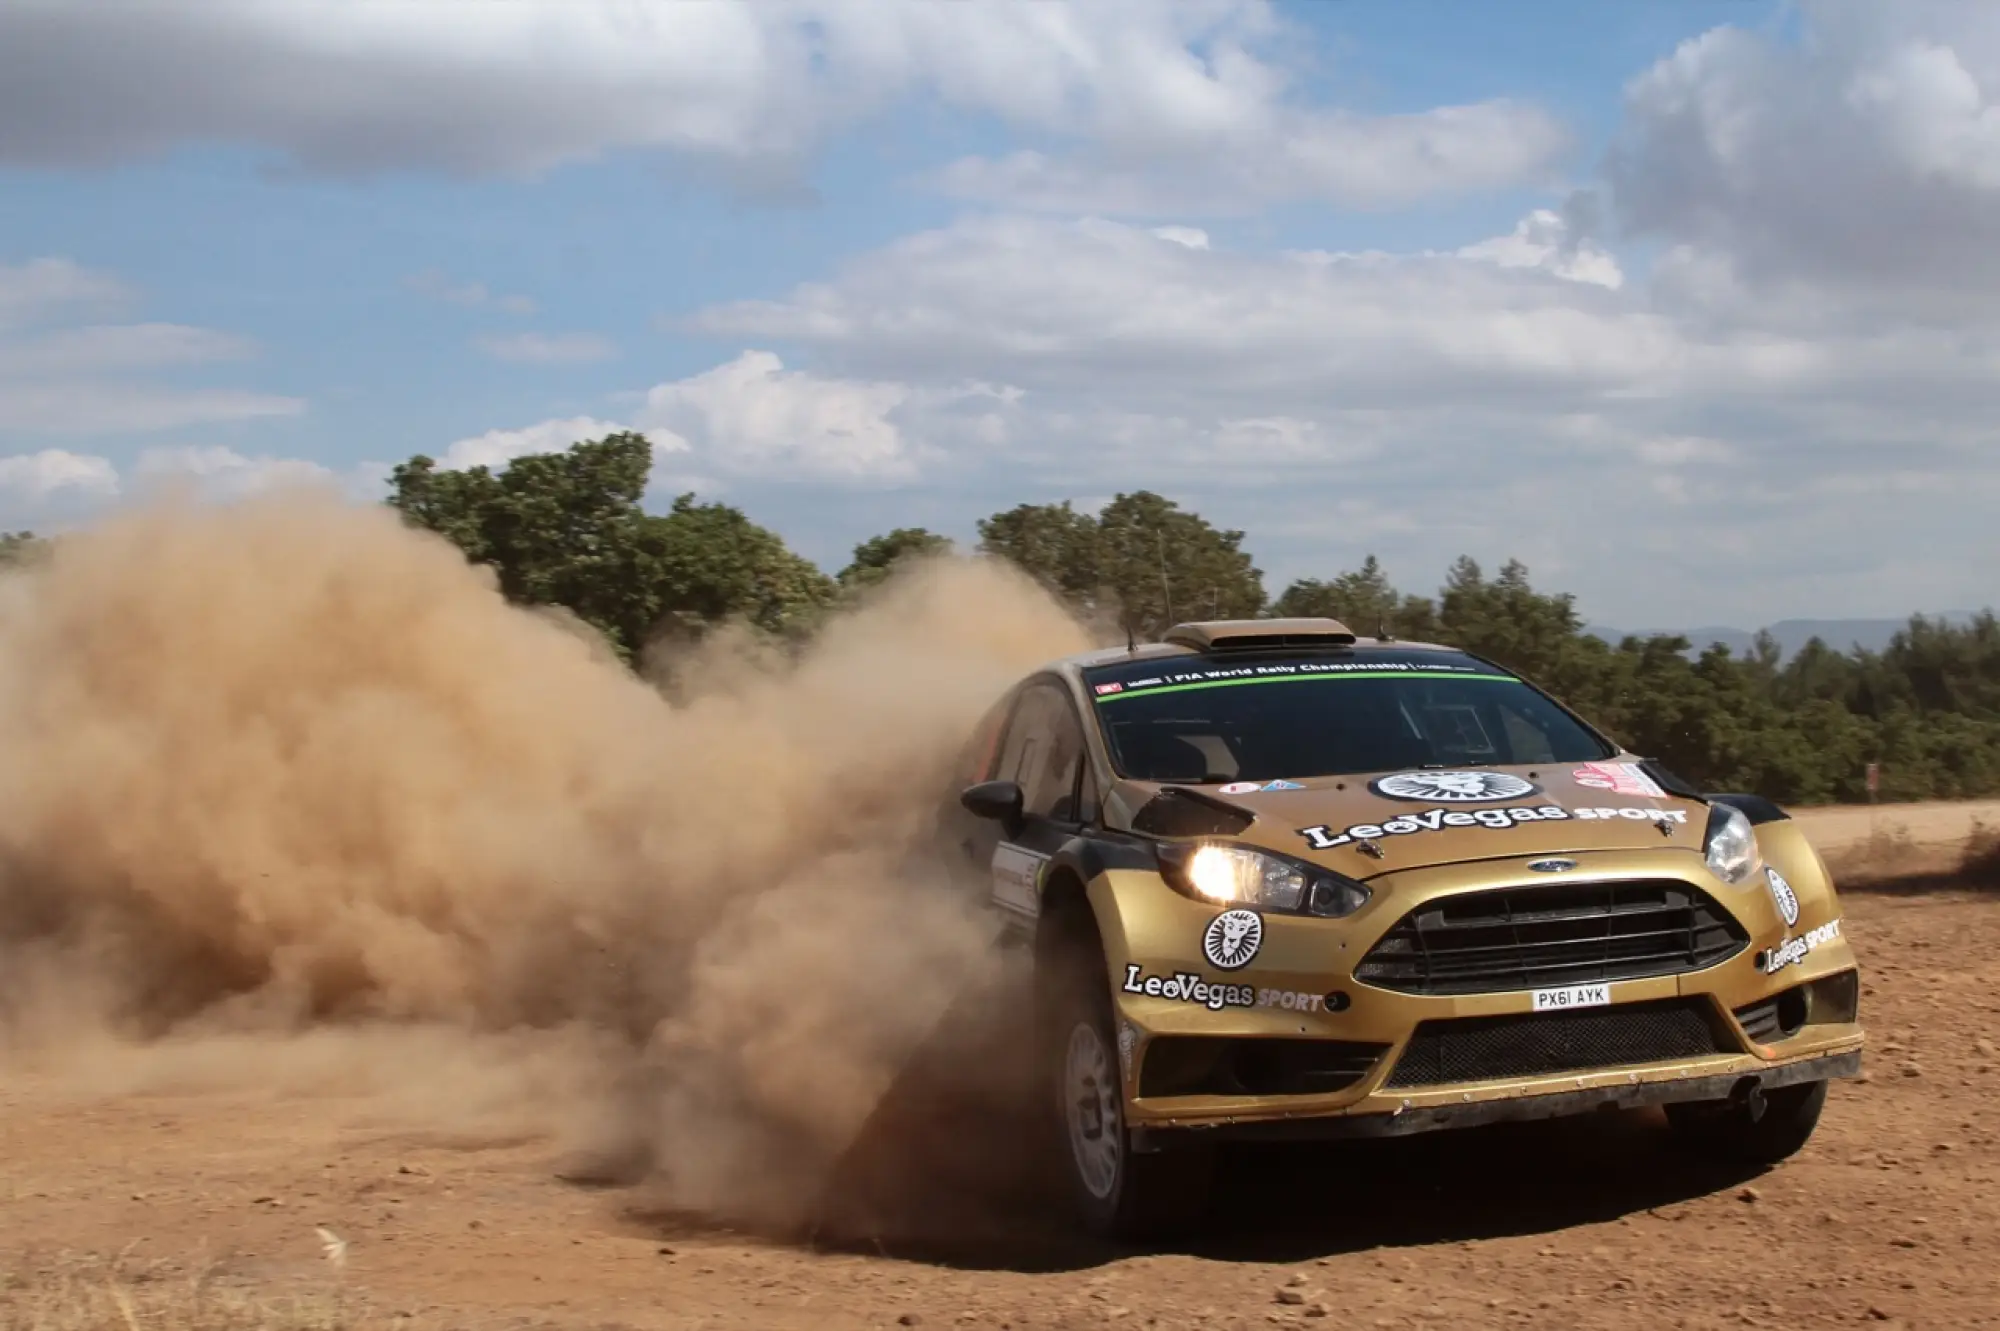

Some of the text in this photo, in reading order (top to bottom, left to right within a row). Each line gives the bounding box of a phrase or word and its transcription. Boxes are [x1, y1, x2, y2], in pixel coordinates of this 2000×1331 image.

[1174, 673, 1203, 682] FIA
[1205, 668, 1253, 678] World
[1256, 664, 1296, 674] Rally
[1300, 662, 1408, 672] Championship
[1301, 806, 1688, 849] LeoVegas SPORT
[1766, 918, 1840, 974] LeoVegas SPORT
[1123, 964, 1324, 1012] LeoVegas SPORT
[1538, 987, 1604, 1007] PX61 AYK
